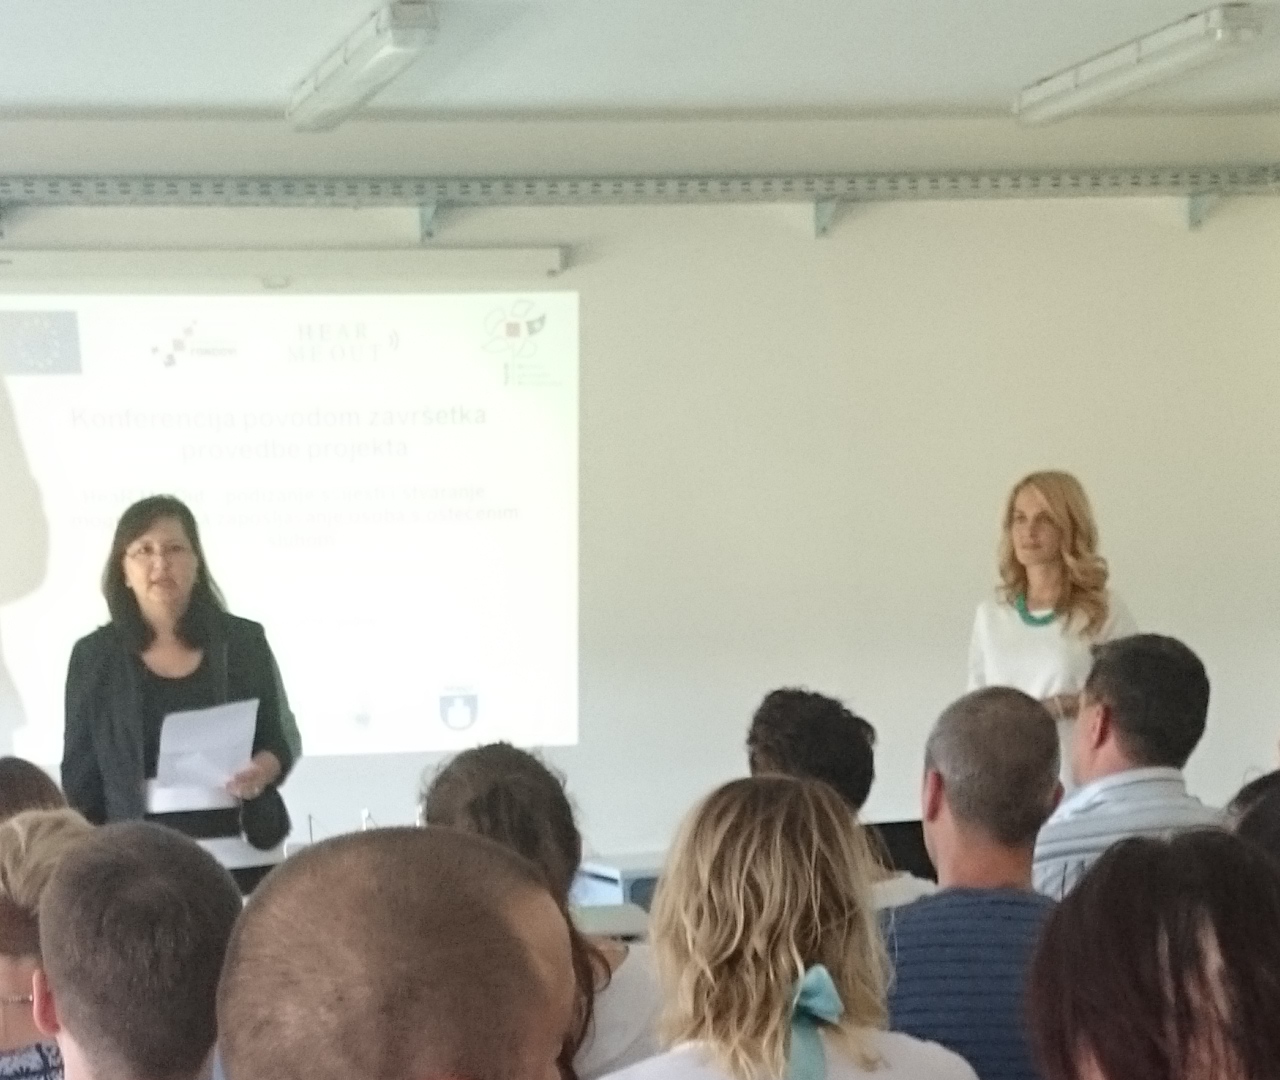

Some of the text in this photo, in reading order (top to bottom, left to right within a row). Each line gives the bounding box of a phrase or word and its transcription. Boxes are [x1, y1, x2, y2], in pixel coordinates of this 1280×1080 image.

[297, 322, 370, 341] HEAR
[287, 343, 384, 364] ME OUT
[70, 404, 487, 433] Konferencija povodom završetka
[181, 437, 408, 463] provedbe projekta
